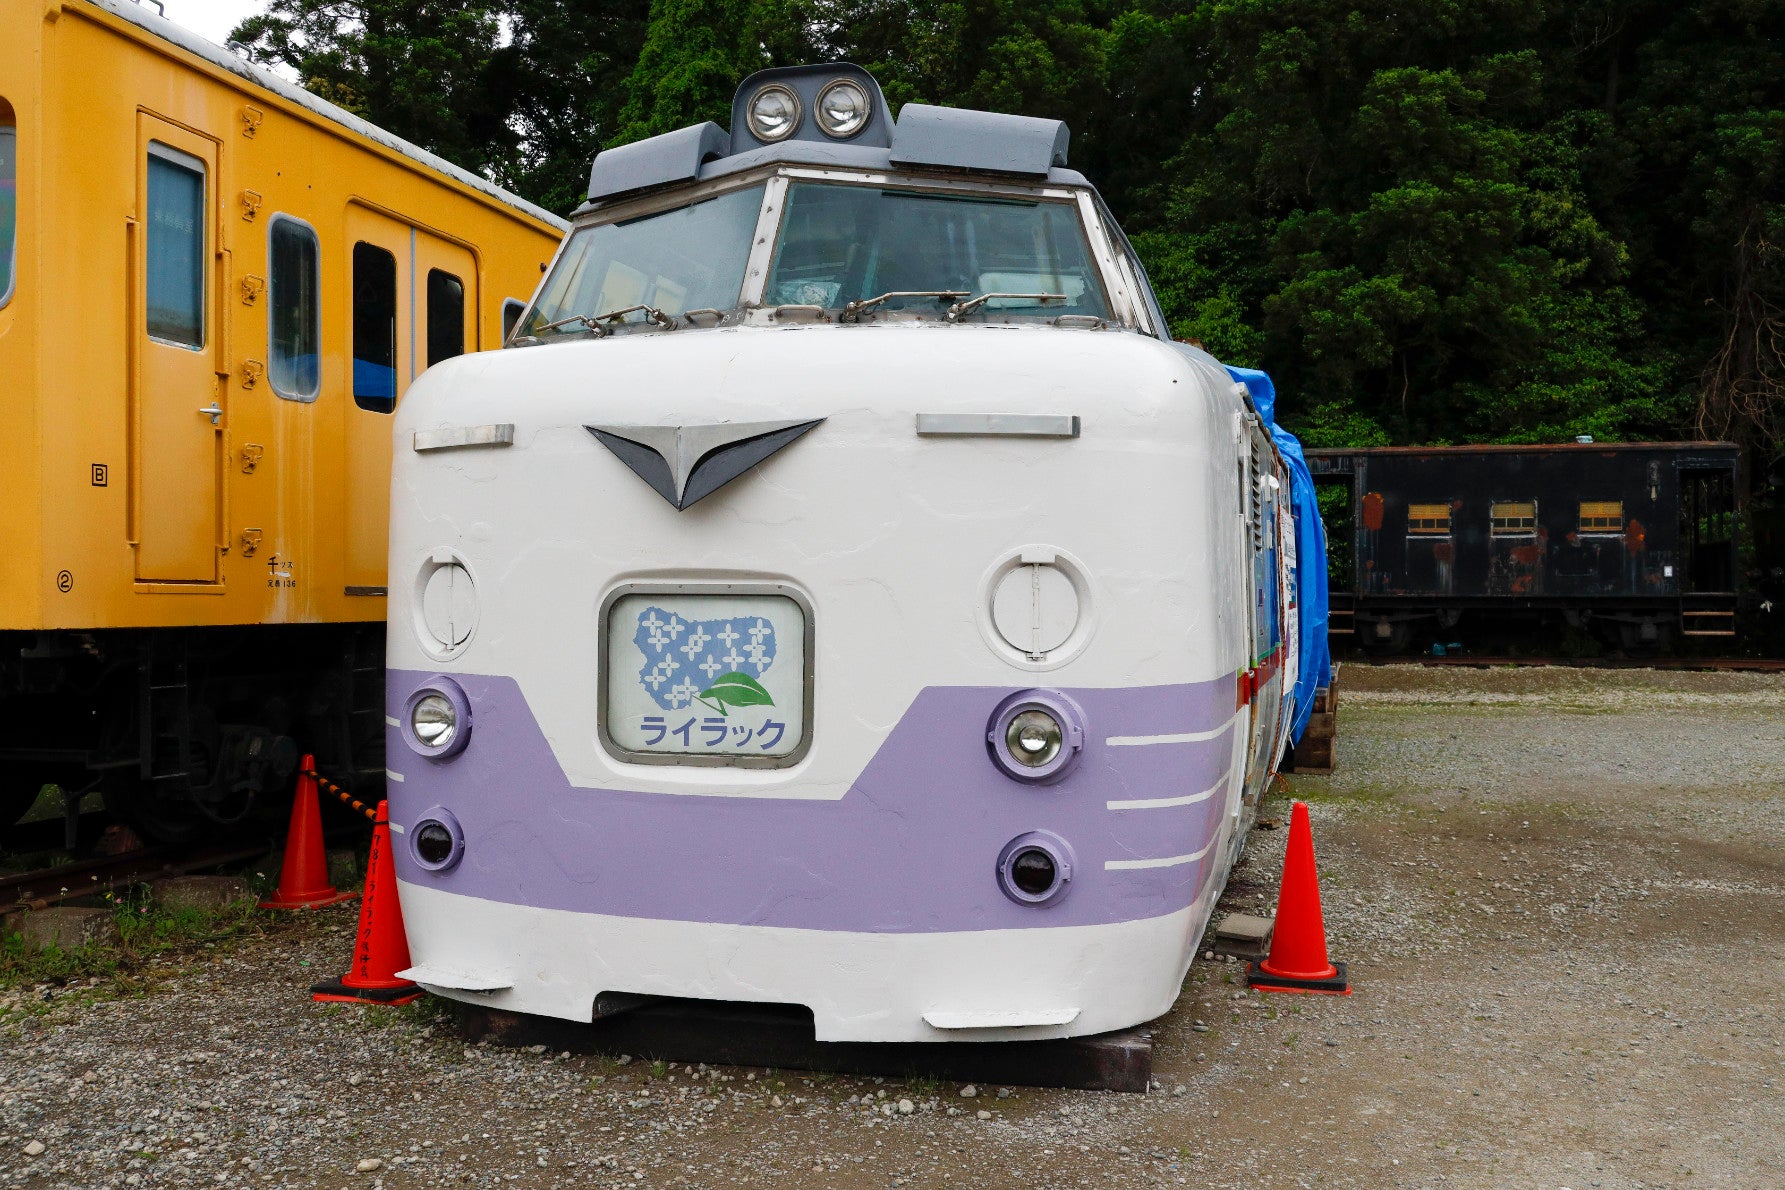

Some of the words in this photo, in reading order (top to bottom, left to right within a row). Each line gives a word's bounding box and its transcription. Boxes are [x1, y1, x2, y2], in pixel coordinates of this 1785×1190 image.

[640, 716, 786, 751] ライラック
